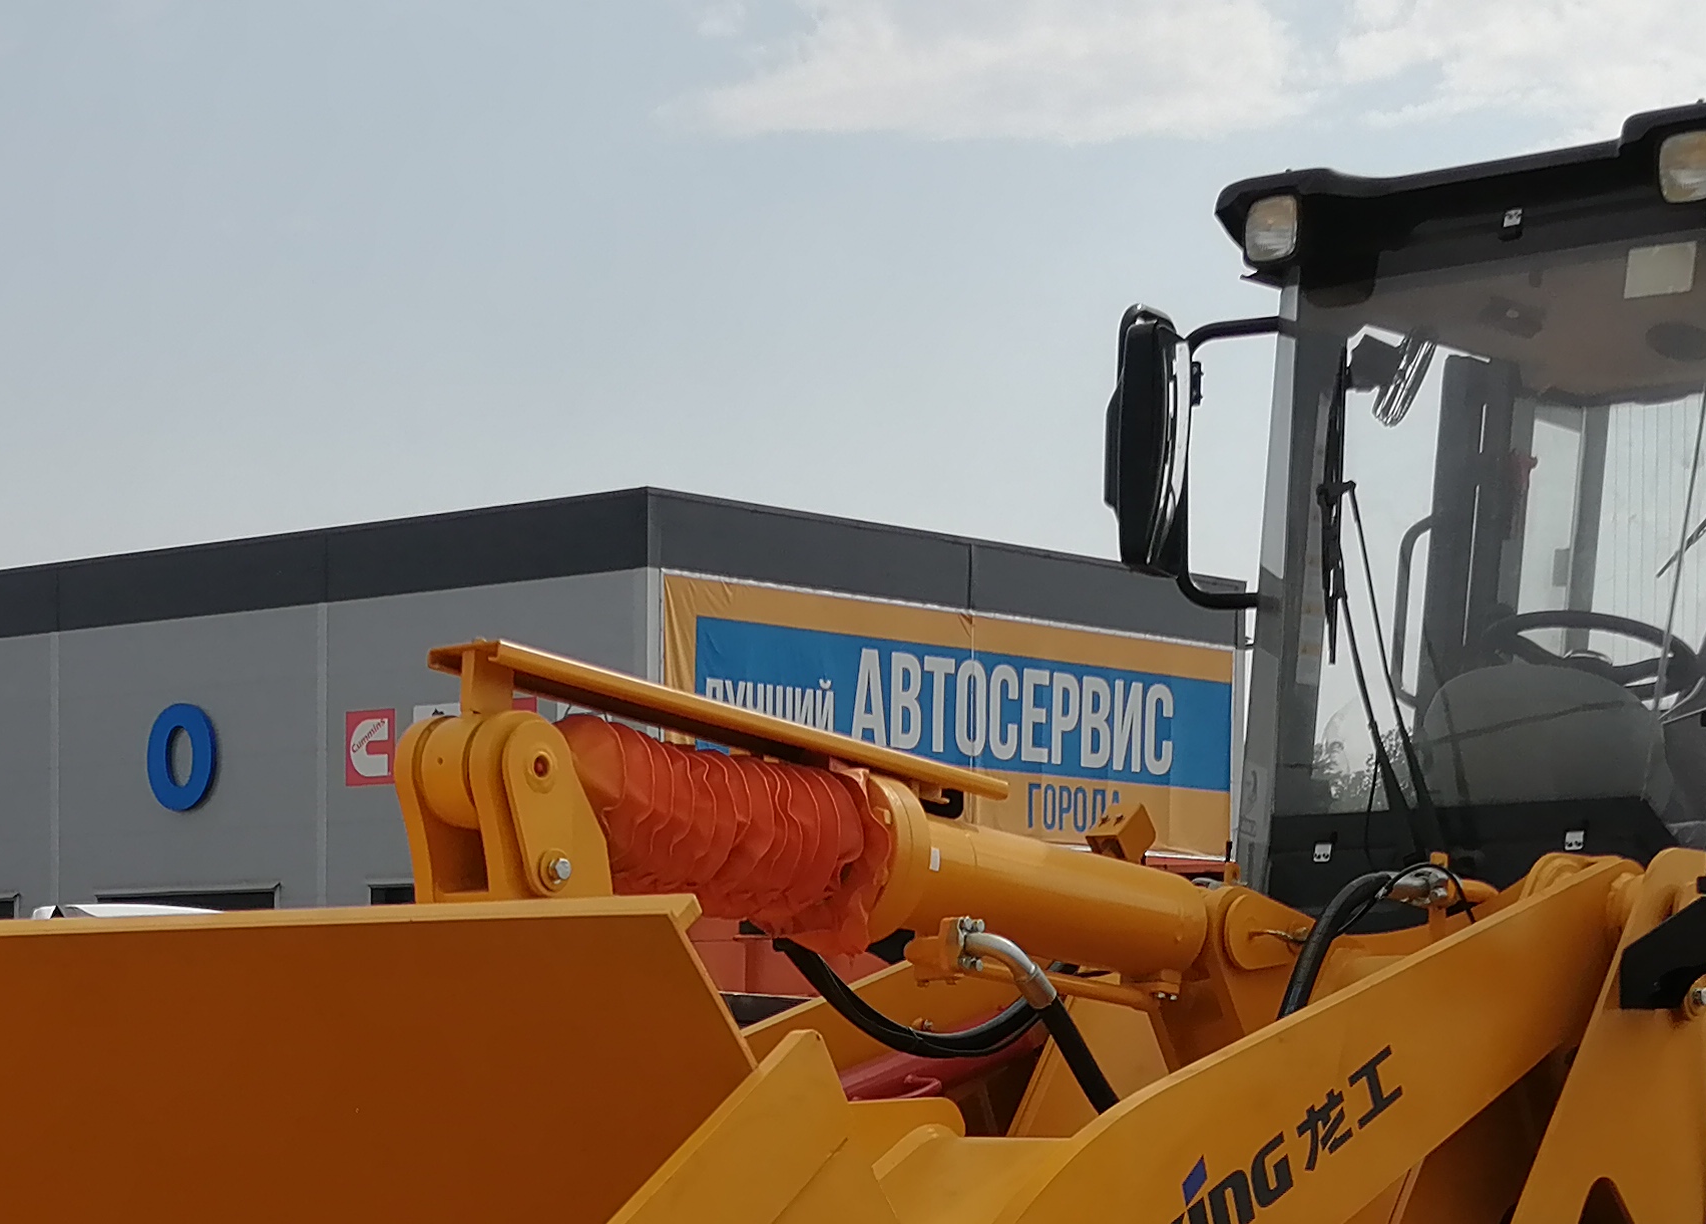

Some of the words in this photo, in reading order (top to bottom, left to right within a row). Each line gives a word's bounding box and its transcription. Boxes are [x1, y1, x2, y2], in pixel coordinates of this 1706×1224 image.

[351, 718, 386, 753] Cummins
[850, 647, 1174, 775] АВТОСЕРВИС
[1028, 782, 1120, 832] ГОРОД
[1297, 1044, 1403, 1171] 龙工
